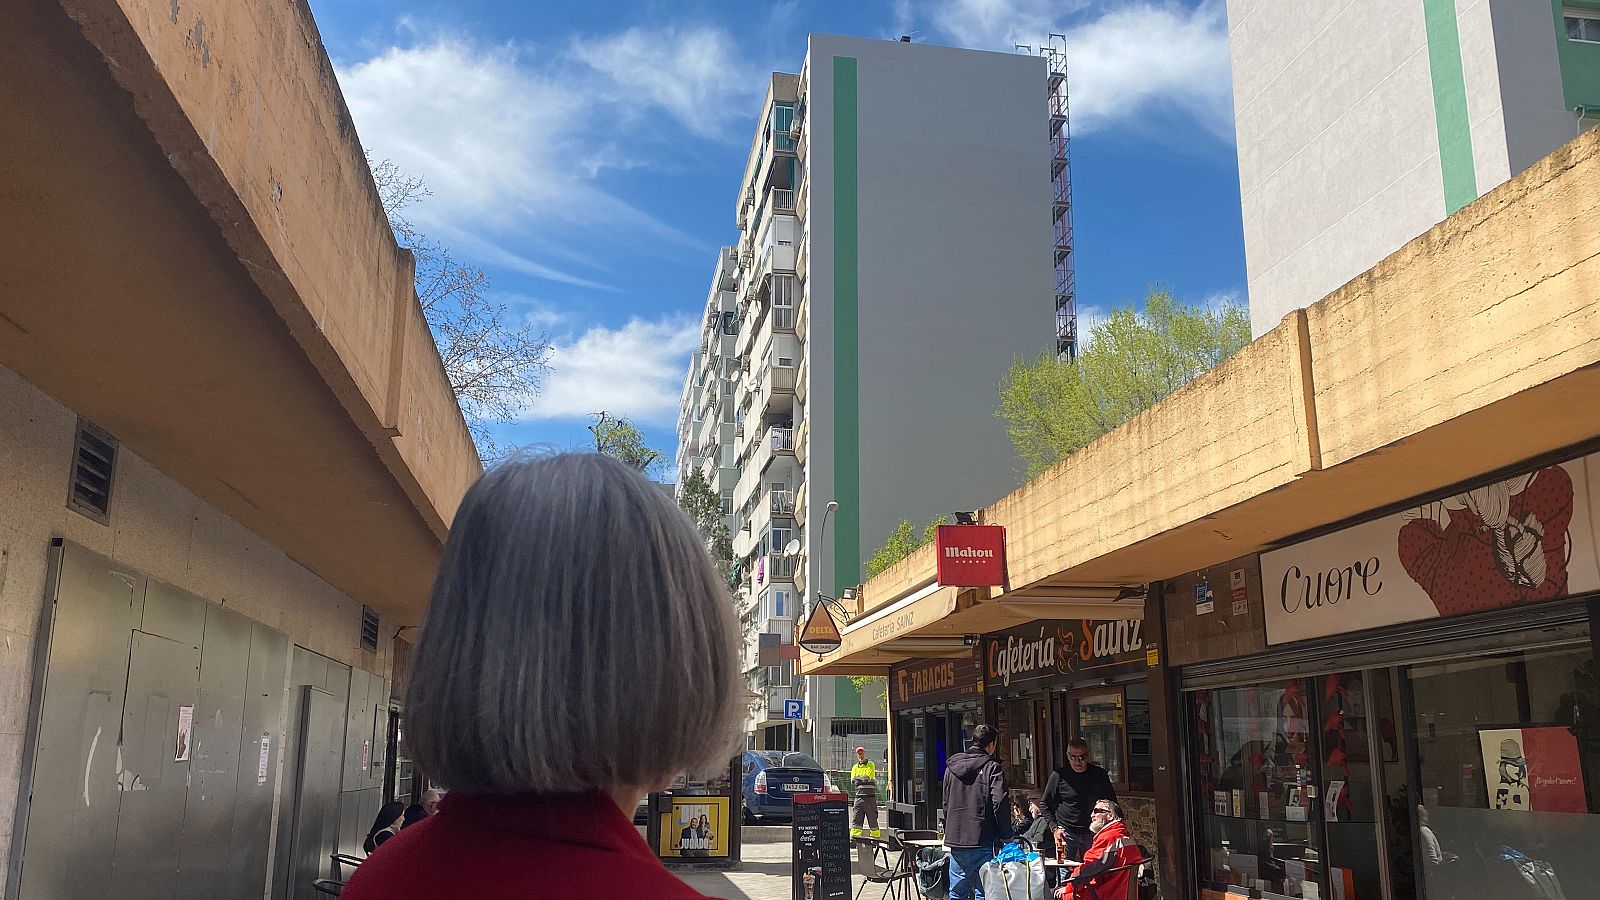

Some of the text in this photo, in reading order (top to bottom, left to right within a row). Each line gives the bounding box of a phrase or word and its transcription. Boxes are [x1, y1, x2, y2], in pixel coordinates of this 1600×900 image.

[944, 545, 994, 559] Mahou
[1280, 556, 1383, 614] Cuore
[809, 626, 834, 634] DELTA
[896, 611, 914, 632] SAINZ
[989, 626, 1055, 688] Cafetería
[912, 663, 955, 694] TABACOS
[788, 701, 800, 717] P
[680, 838, 709, 850] JUGADO
